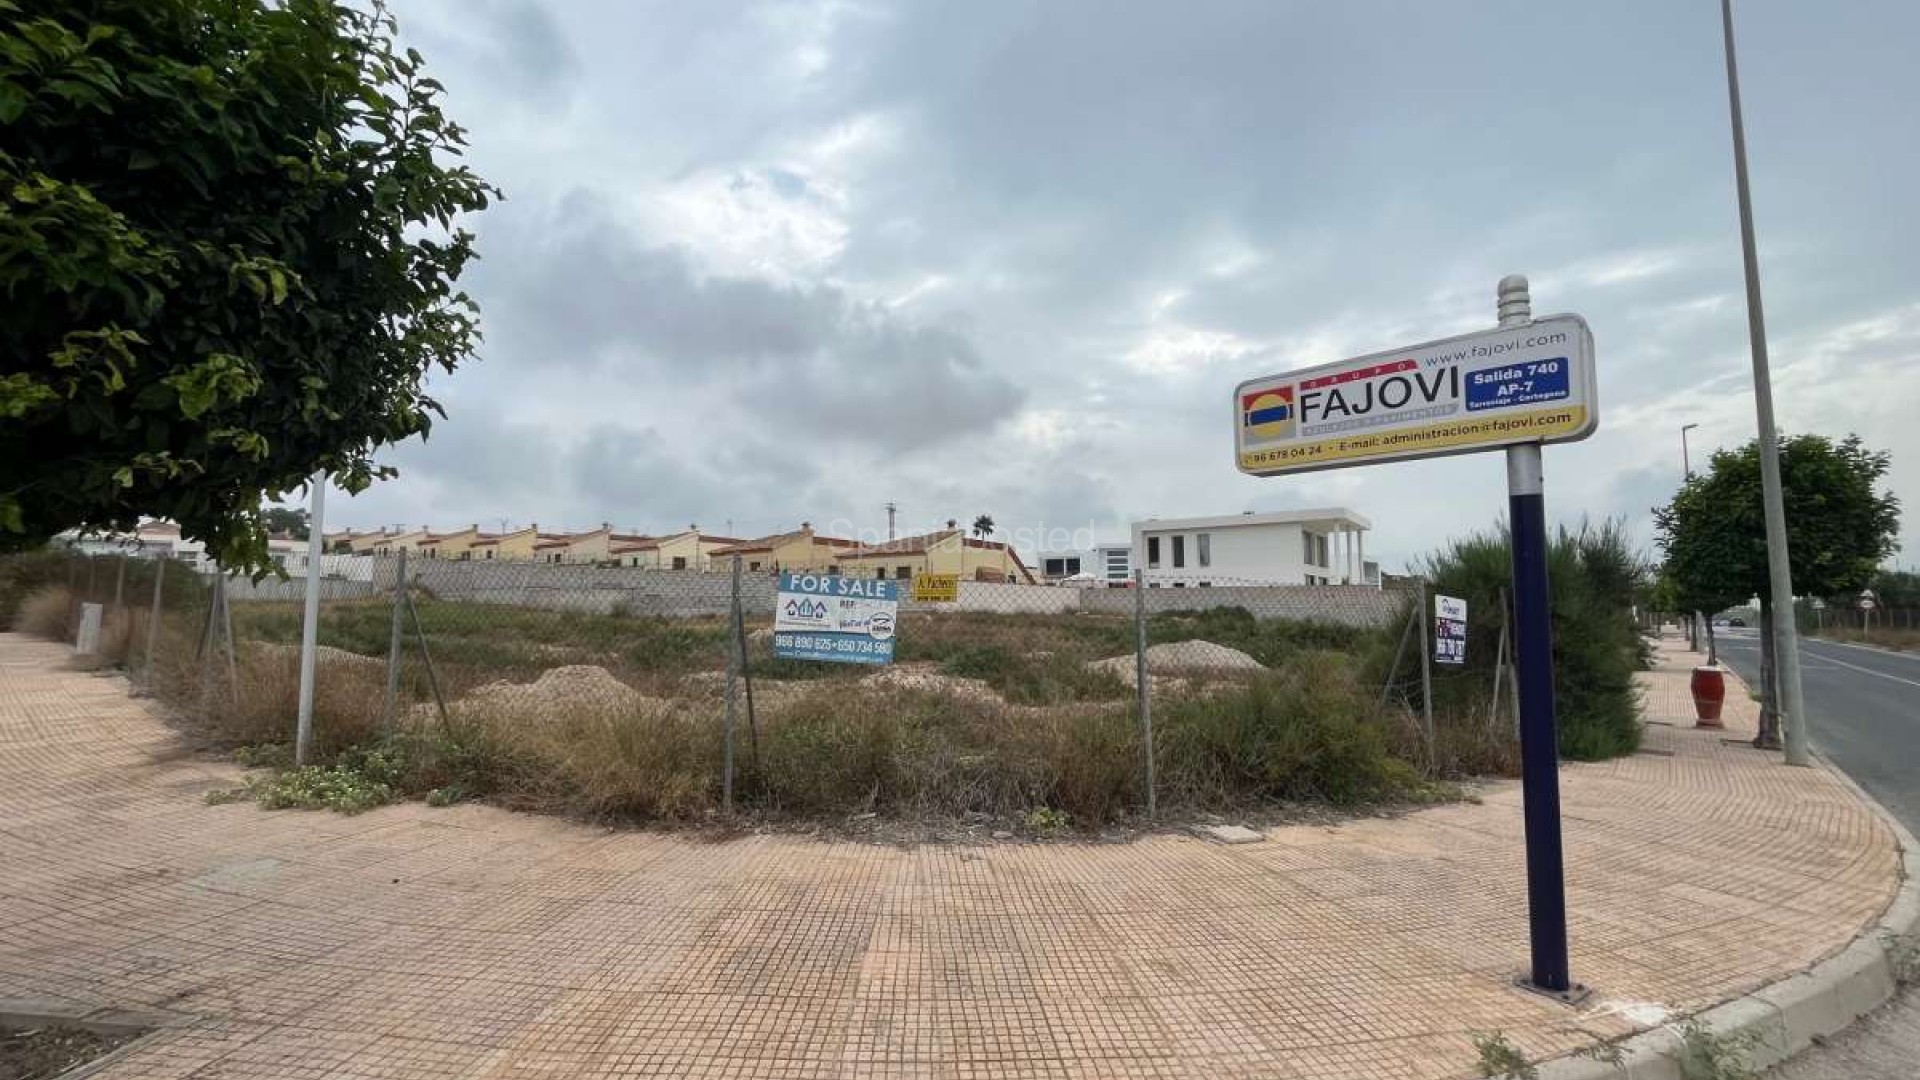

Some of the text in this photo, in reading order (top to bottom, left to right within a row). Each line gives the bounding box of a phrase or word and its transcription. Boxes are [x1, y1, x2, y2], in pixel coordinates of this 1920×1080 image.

[1425, 332, 1567, 367] www.fajovi.com
[1474, 362, 1559, 385] Salida 740
[1300, 366, 1459, 424] FAJOVI
[1497, 381, 1534, 397] AP-7
[1339, 439, 1380, 451] E-mail:
[790, 574, 887, 598] FOR SALE
